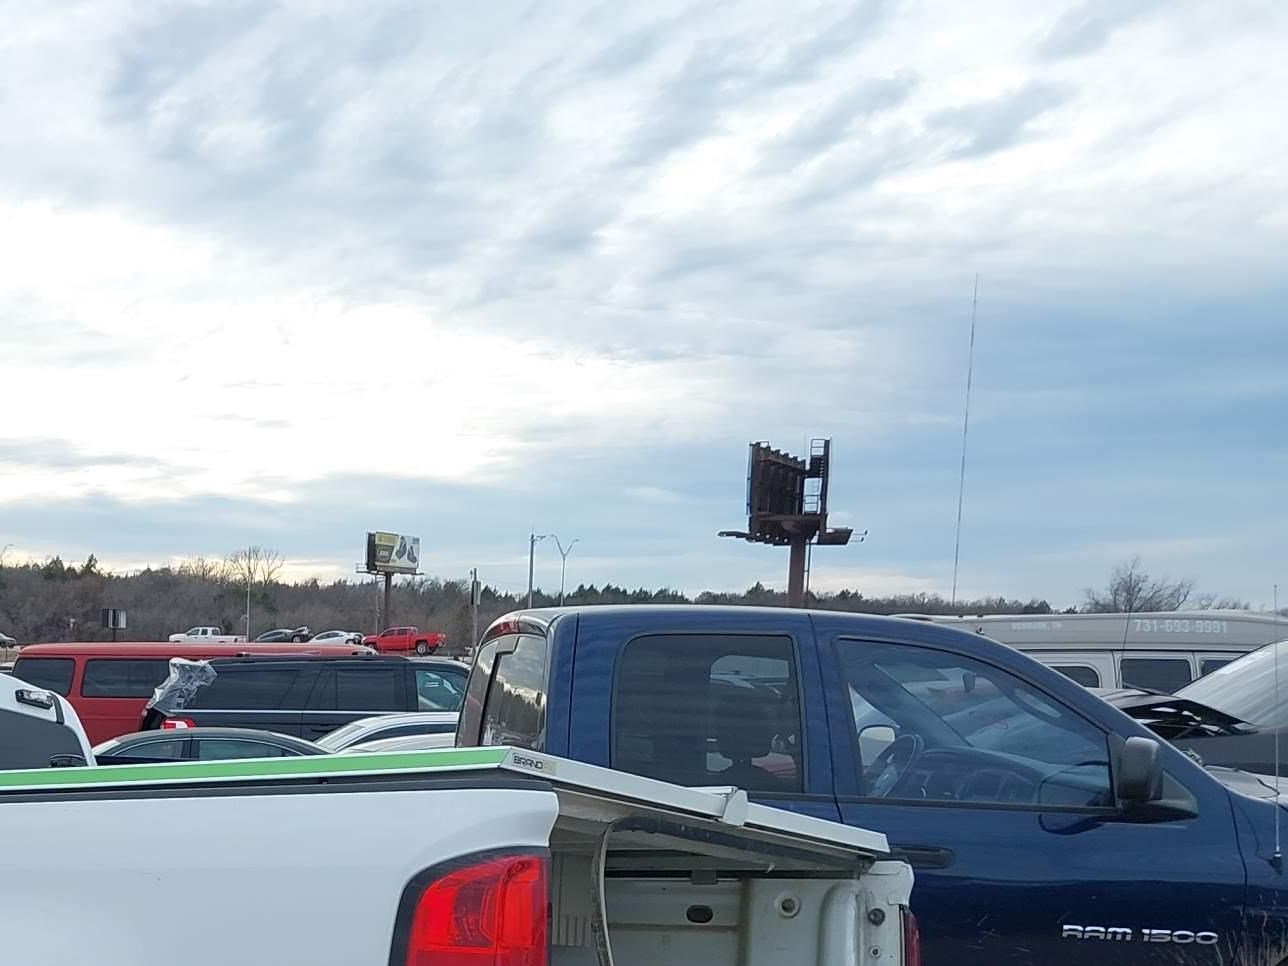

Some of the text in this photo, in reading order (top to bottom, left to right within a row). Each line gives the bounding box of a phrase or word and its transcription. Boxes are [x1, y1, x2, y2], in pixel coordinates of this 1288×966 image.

[1133, 619, 1228, 633] 731-693-9991
[1062, 924, 1219, 945] RAM 1500
